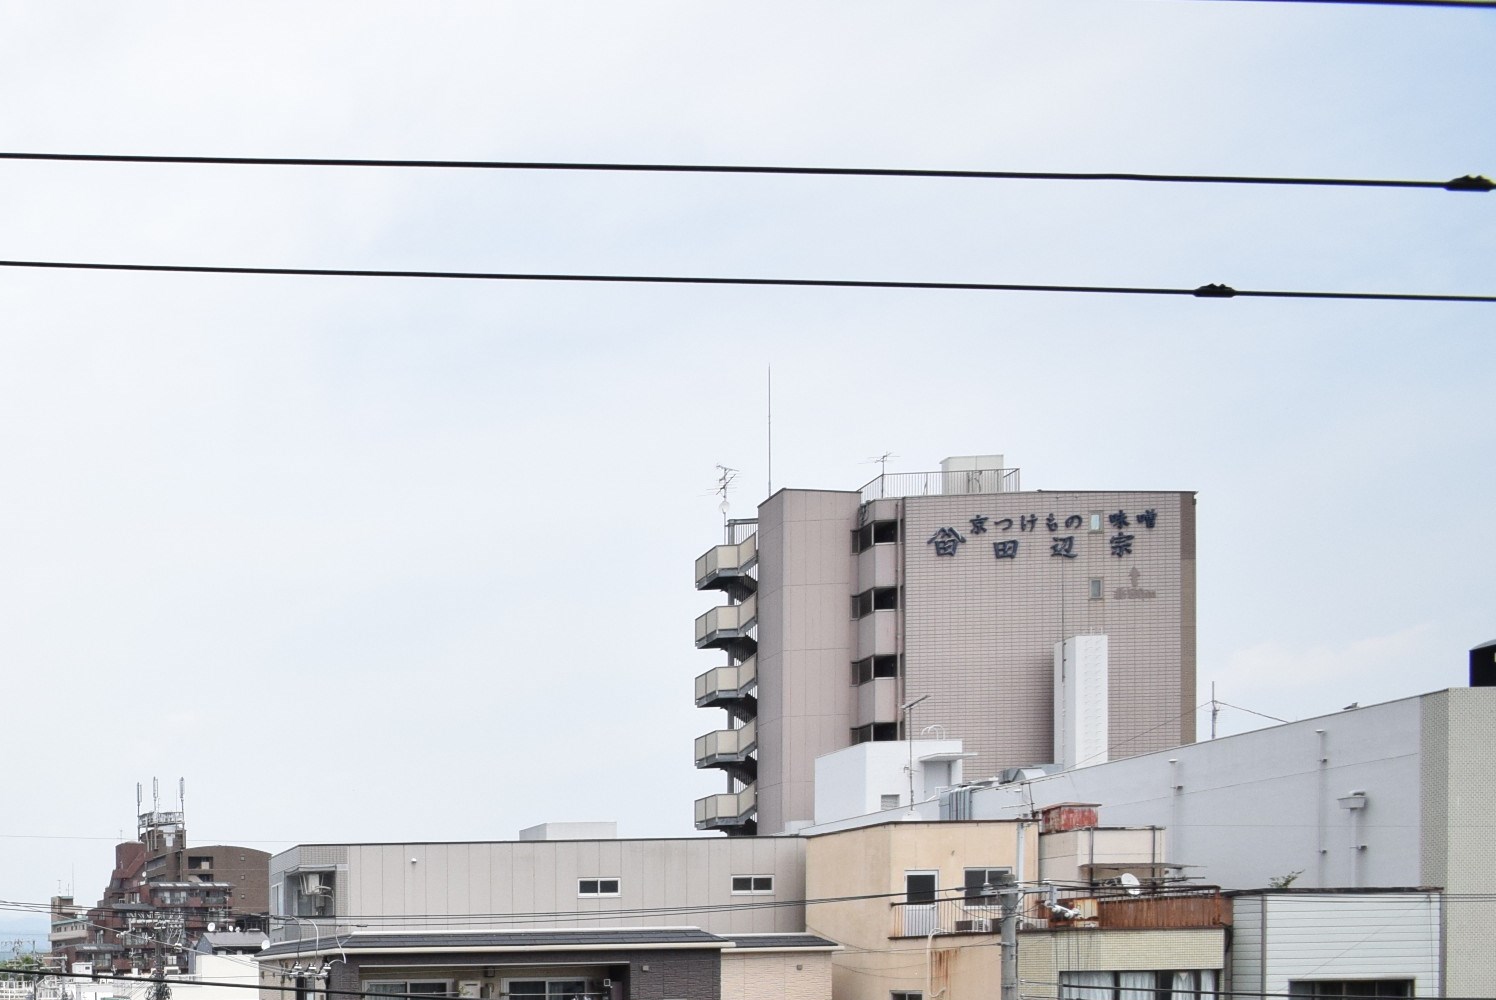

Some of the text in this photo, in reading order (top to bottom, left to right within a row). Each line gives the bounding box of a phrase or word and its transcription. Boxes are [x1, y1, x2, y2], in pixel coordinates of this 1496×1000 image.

[969, 508, 1158, 534] 京つけもの 味噌
[993, 532, 1135, 559] 田辺宗
